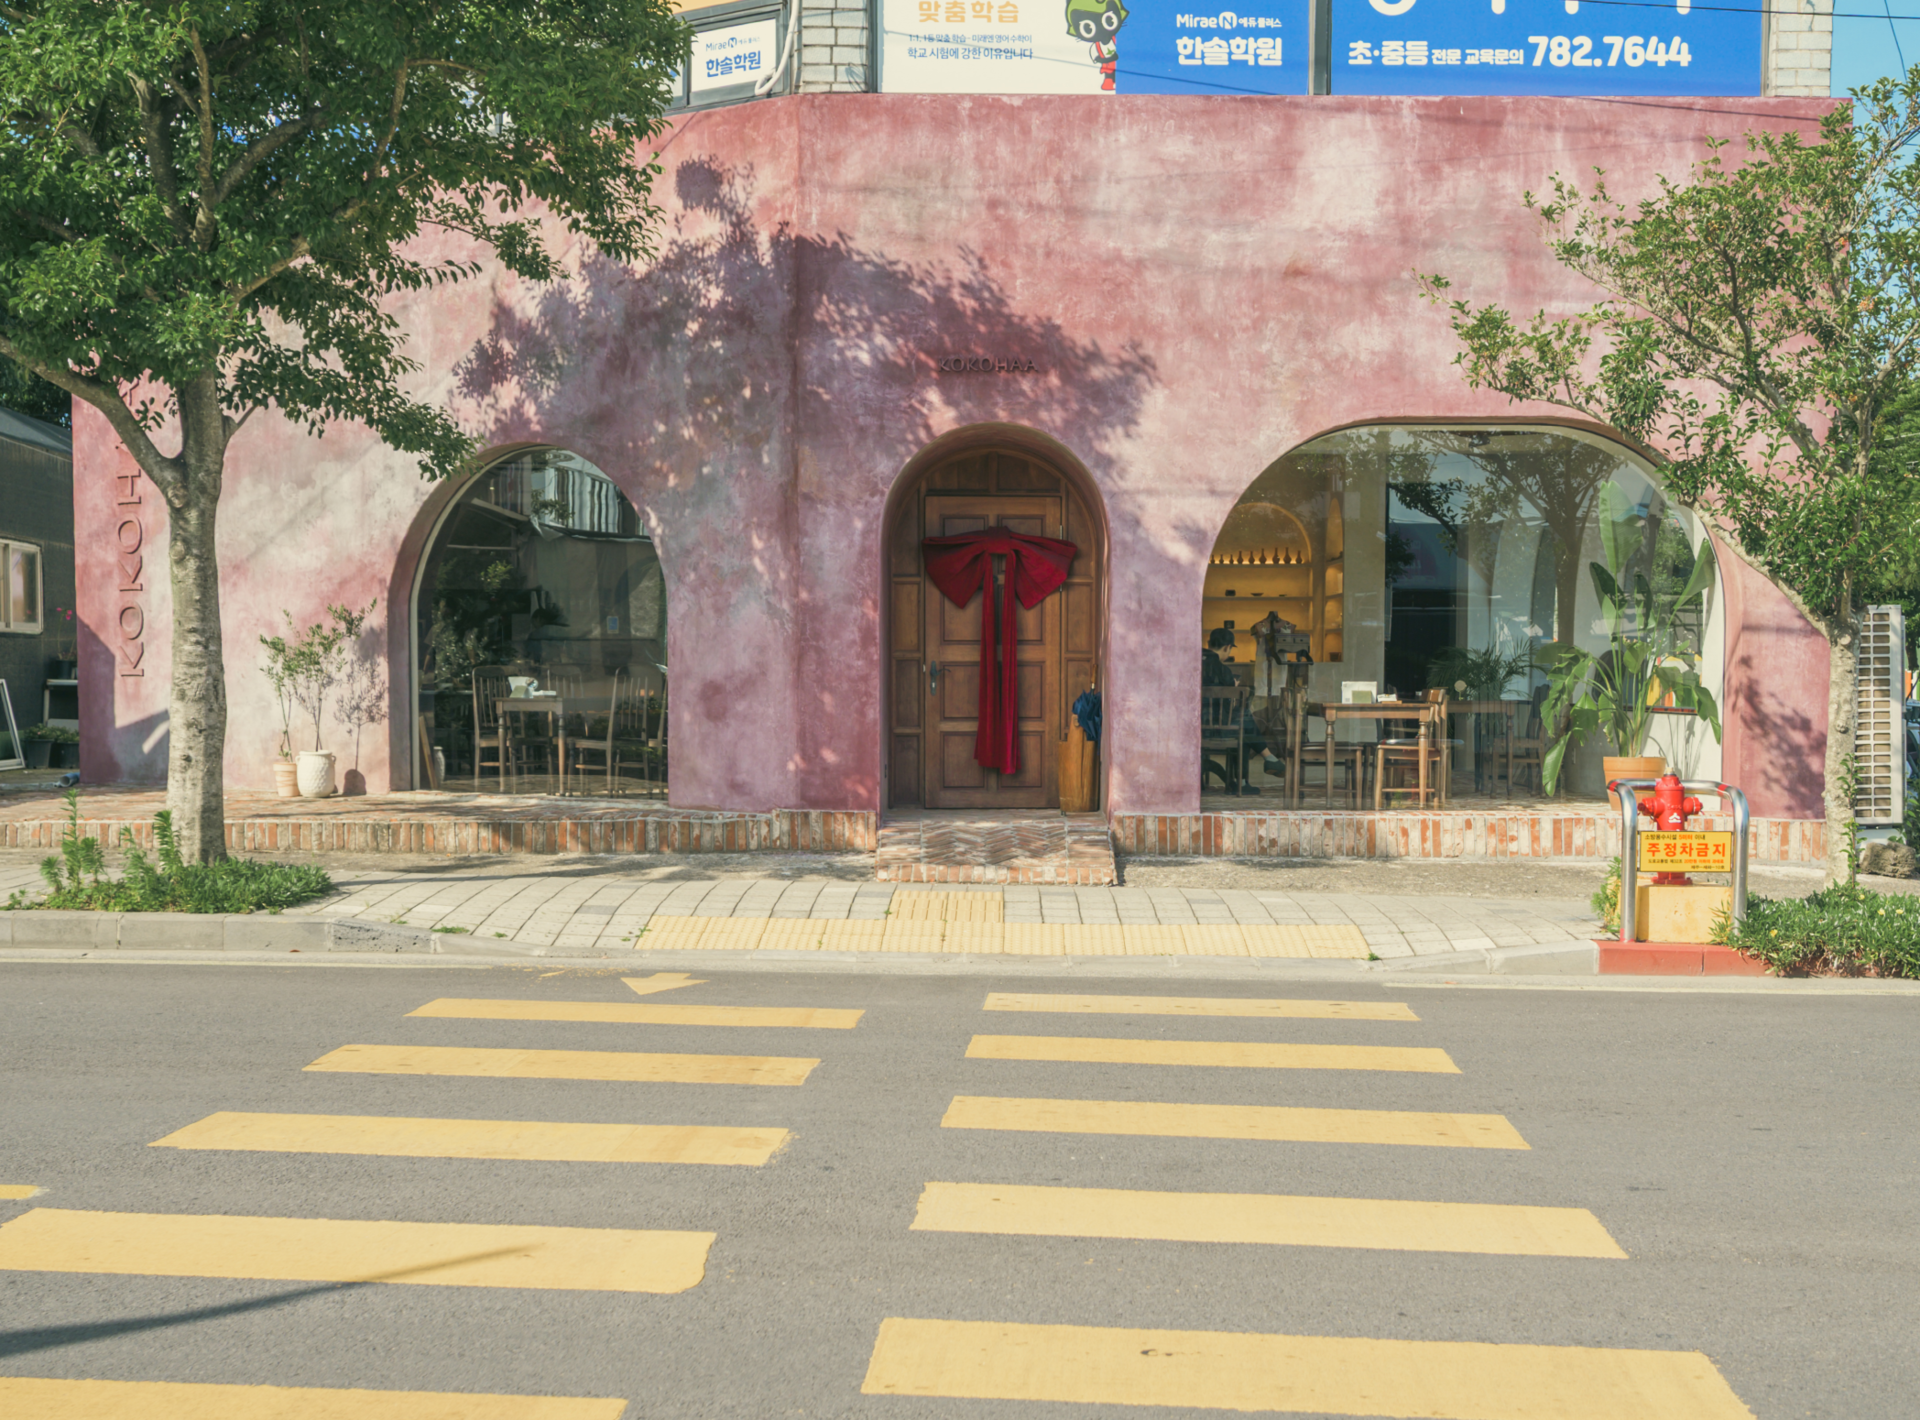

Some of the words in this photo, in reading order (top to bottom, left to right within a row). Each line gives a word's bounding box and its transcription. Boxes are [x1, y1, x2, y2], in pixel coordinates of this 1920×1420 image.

[918, 0, 1019, 23] 맞춤학습
[907, 47, 927, 59] 학교
[929, 47, 959, 59] 시험에
[961, 47, 981, 59] 강한
[983, 47, 1033, 60] 이유입니다
[1176, 36, 1282, 66] 한솔학원
[1431, 49, 1461, 64] 전문
[1464, 49, 1524, 64] 교육문의
[1528, 36, 1692, 67] 782.7644
[706, 50, 761, 78] 한솔학원
[939, 358, 1039, 373] KOKOHAA
[1646, 842, 1726, 858] 주정차금지
